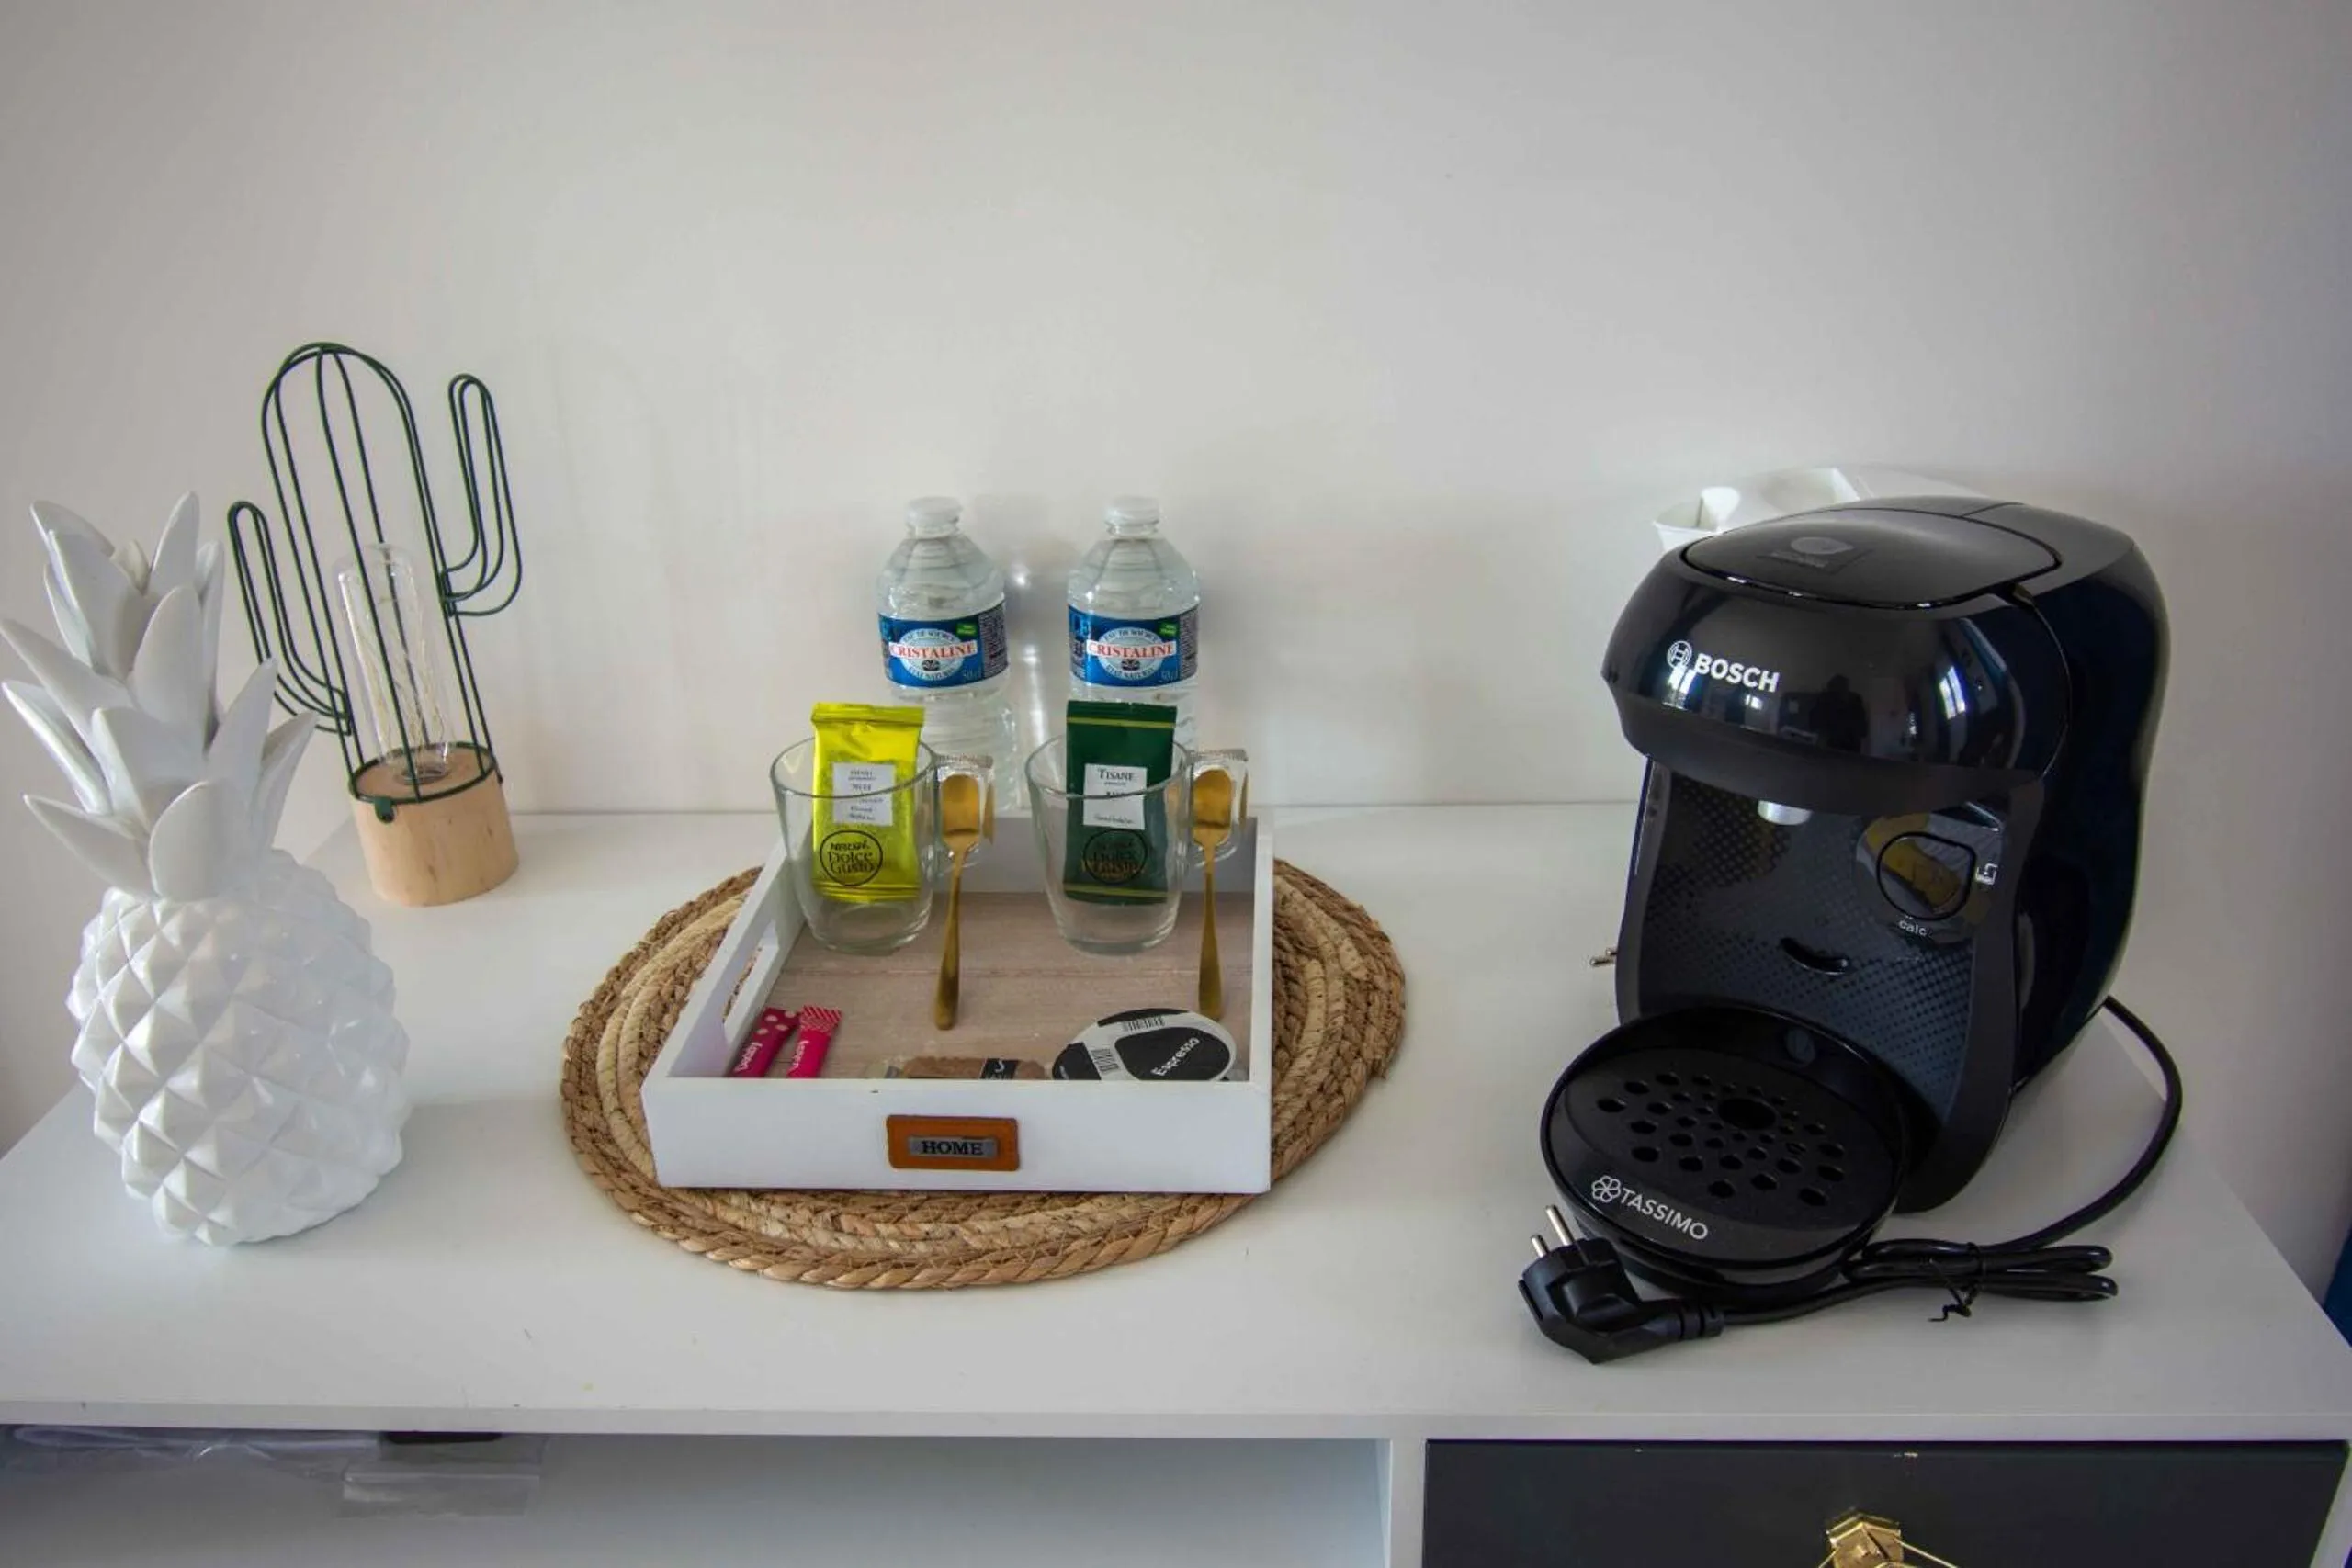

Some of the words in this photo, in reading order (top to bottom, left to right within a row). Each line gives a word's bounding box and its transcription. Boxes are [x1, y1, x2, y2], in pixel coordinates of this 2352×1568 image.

[1694, 652, 1781, 693] BOSCH
[1898, 919, 1928, 936] calc
[1150, 1037, 1200, 1077] Espresso
[922, 1141, 984, 1156] HOME
[1621, 1187, 1708, 1240] TASSIMO
